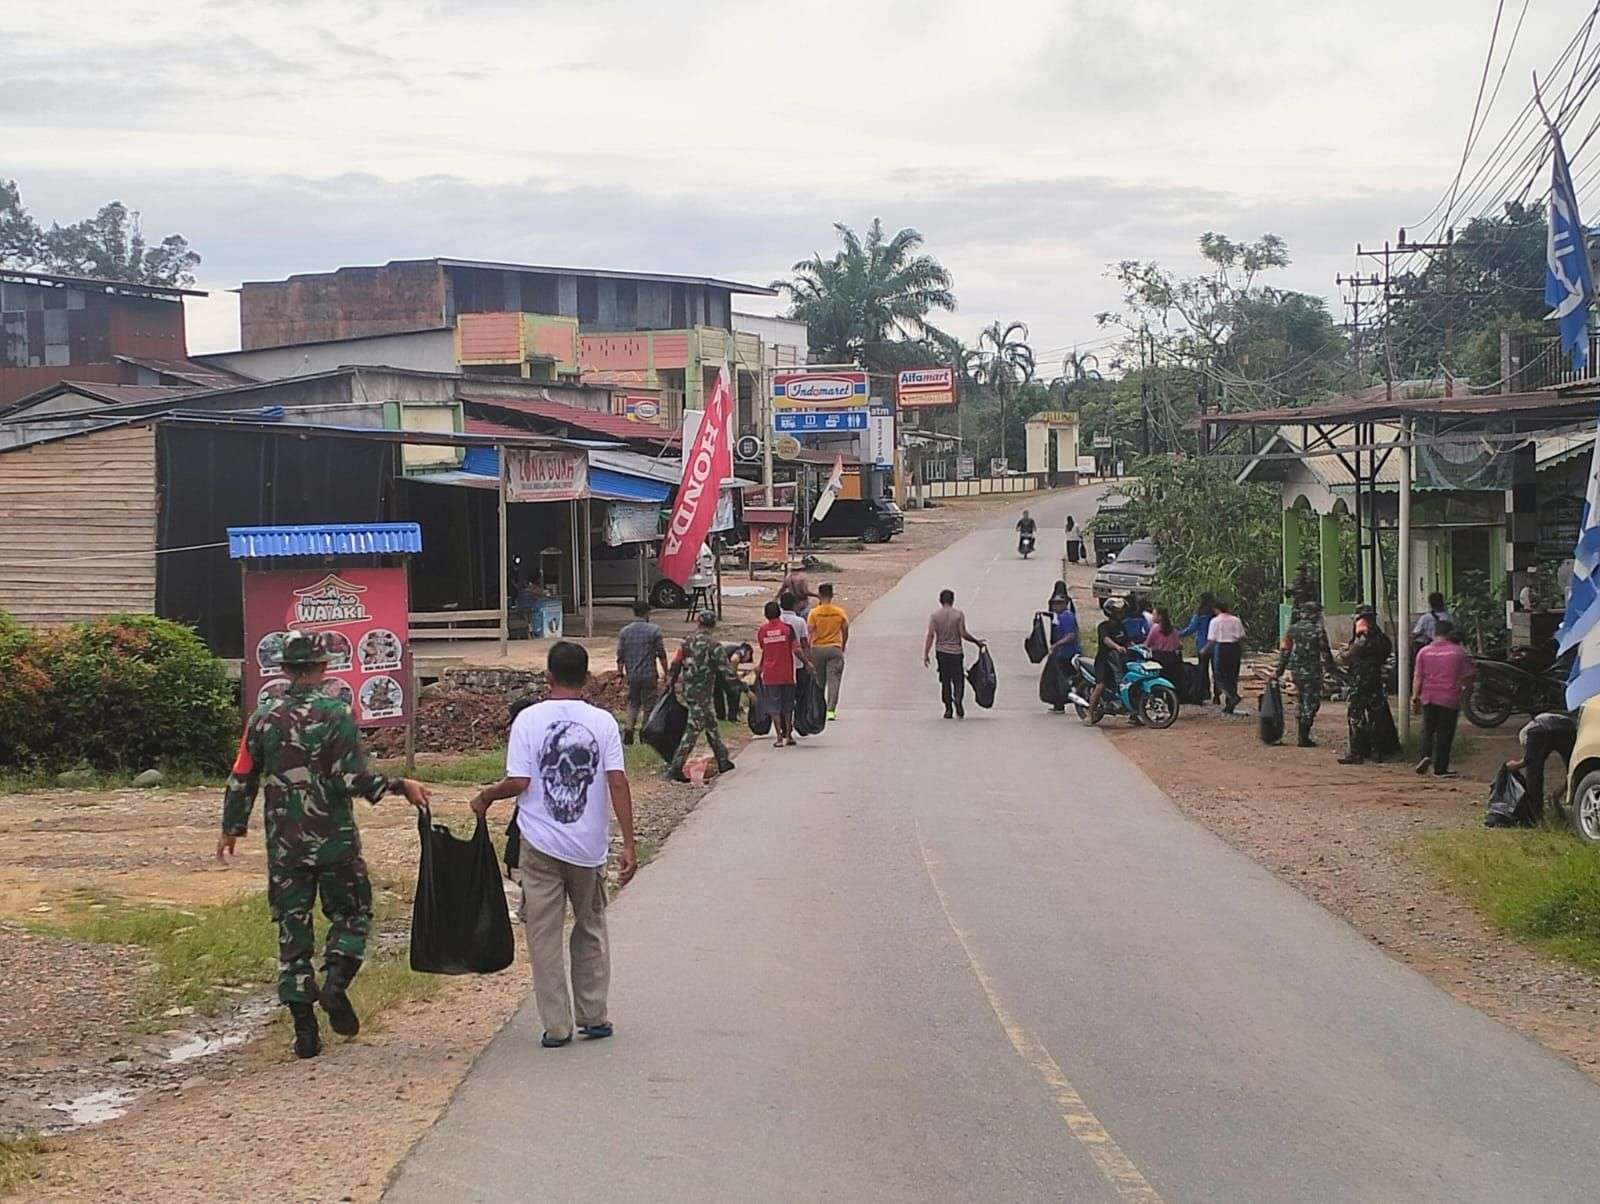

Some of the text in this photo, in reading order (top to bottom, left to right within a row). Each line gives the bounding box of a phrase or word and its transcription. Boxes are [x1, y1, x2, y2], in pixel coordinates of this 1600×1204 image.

[901, 371, 949, 384] Alfamart
[790, 382, 850, 398] Indomaret
[871, 407, 889, 416] atm
[664, 418, 719, 556] HONDA
